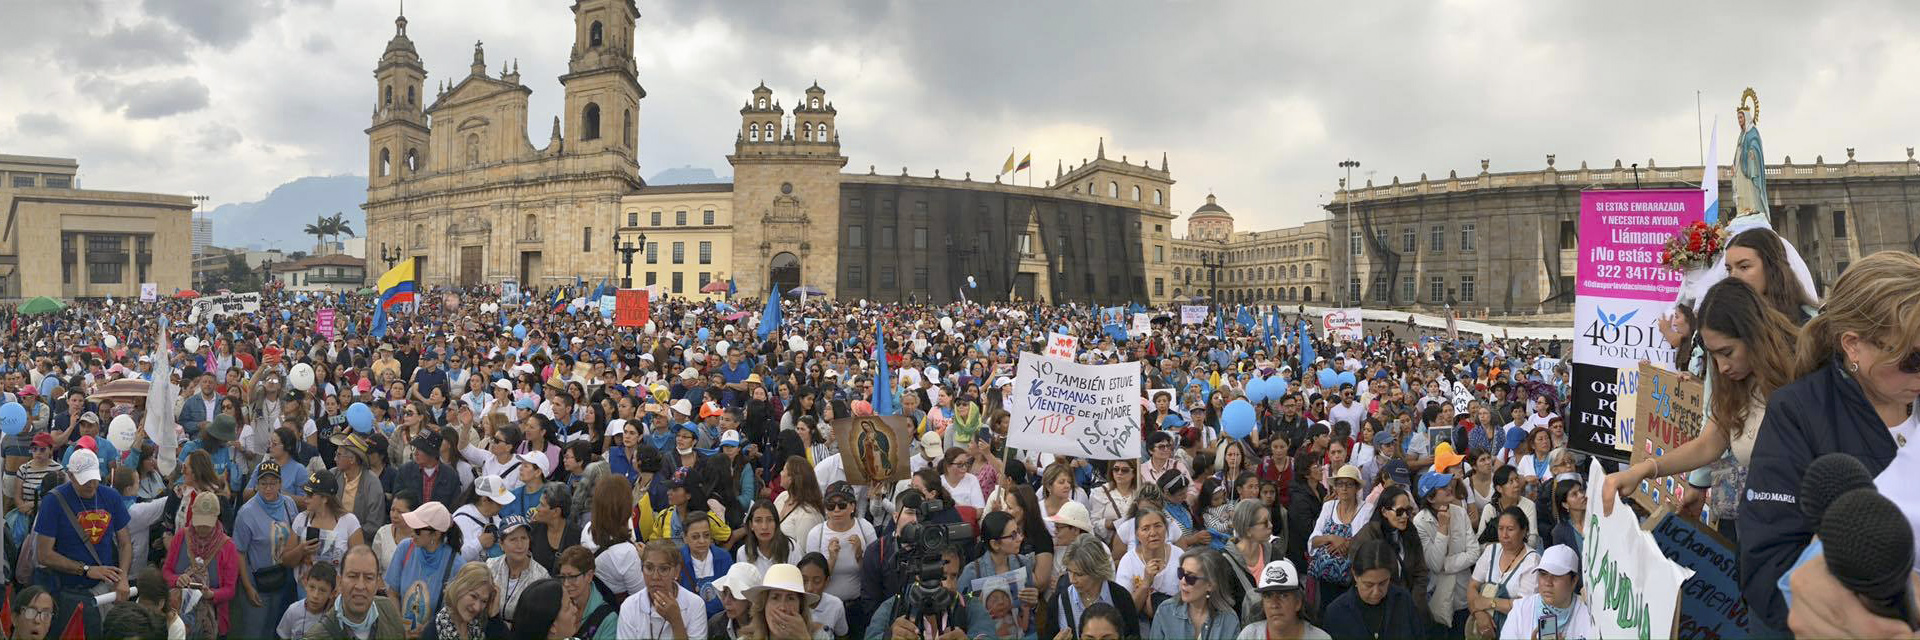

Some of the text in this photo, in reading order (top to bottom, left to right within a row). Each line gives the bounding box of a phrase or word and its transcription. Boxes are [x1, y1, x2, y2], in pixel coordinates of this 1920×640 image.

[1596, 202, 1685, 212] SI ESTAS EMBARAZADA
[1602, 216, 1679, 225] Y NECESITAS AYUDA
[1611, 227, 1672, 244] Llámanos
[1591, 247, 1614, 262] ¡No
[1618, 247, 1652, 263] estás
[1597, 265, 1683, 281] 322 3417515
[1583, 280, 1681, 294] 40diasporlavidacolombia@gma
[1600, 345, 1677, 363] POR LA VI
[1030, 361, 1134, 391] YO TAMBIÉN ESTUVE
[1618, 371, 1639, 397] ABO
[1028, 379, 1125, 406] 16 SEMANAS EN EL
[1590, 381, 1618, 396] OR
[1651, 375, 1670, 418] 1/3
[1674, 381, 1700, 408] de mi
[1027, 396, 1077, 416] VIENTRE
[1078, 409, 1091, 418] DE
[1104, 404, 1132, 420] MADRE
[1598, 398, 1617, 413] PO
[1670, 401, 1703, 423] generac
[1022, 415, 1036, 433] Y
[1581, 412, 1616, 430] FIN
[1589, 432, 1616, 446] AB
[1620, 418, 1634, 445] NE
[1771, 492, 1796, 503] MARIA
